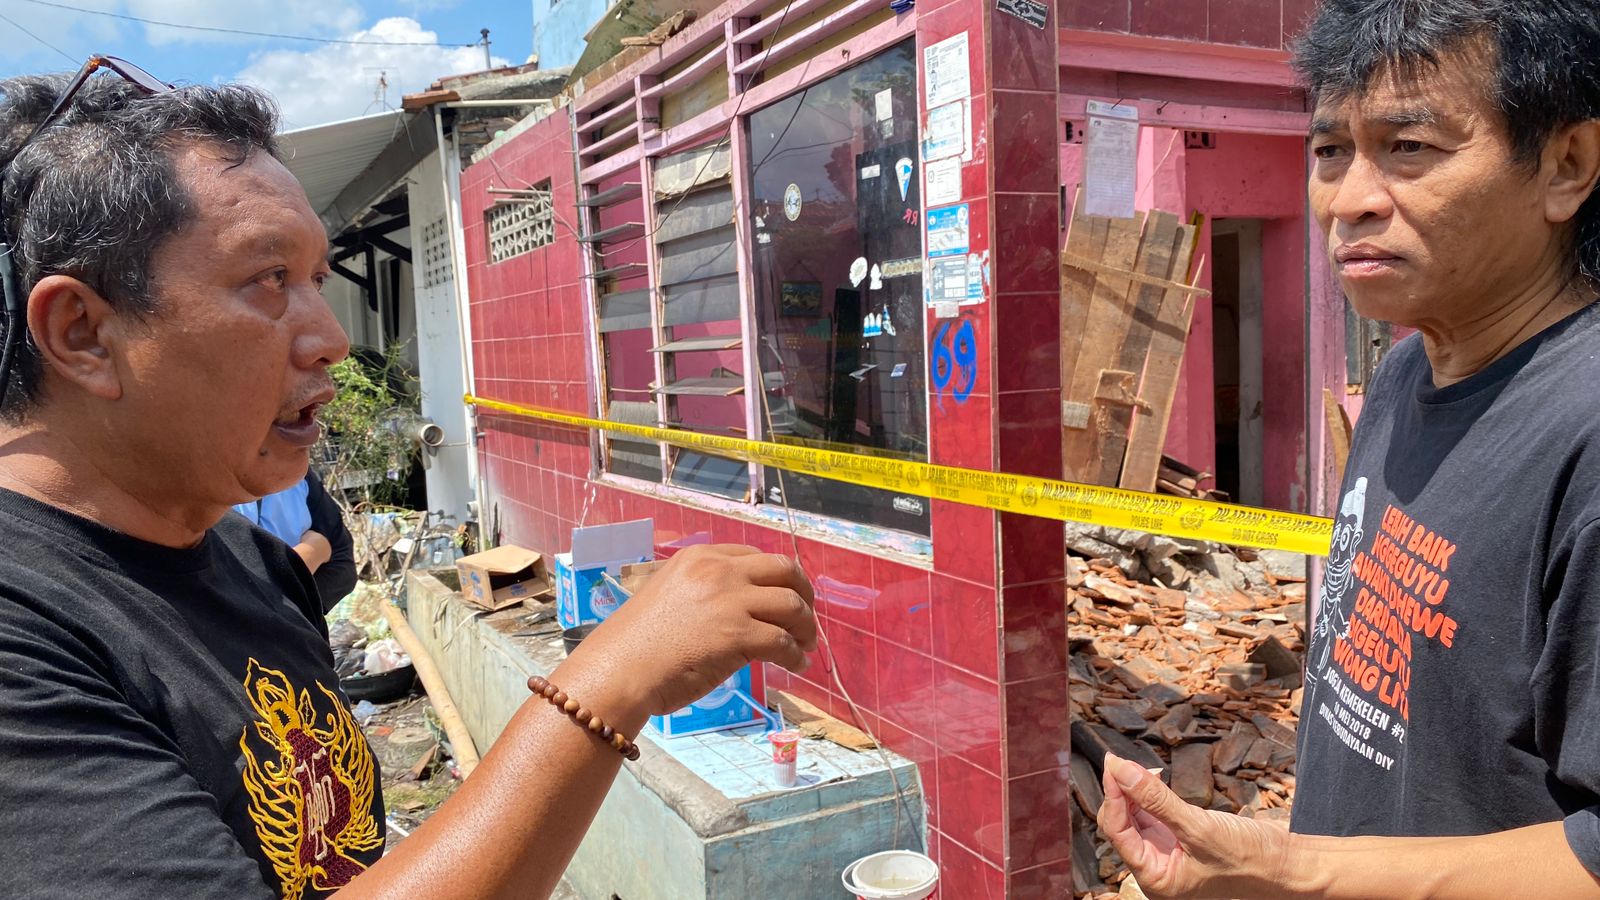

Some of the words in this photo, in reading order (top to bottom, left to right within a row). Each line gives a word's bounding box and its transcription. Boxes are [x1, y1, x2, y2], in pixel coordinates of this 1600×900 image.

[931, 319, 977, 408] 69
[1370, 530, 1450, 606] NGGEGUYU
[1381, 503, 1415, 546] LEBIH
[1406, 524, 1457, 572] BAIK
[1388, 581, 1458, 649] DHEWE
[1333, 635, 1380, 693] WONG
[1332, 717, 1375, 760] KEBUDAYAAN
[1374, 751, 1395, 771] DIY
[1338, 706, 1352, 726] MEI
[1348, 717, 1372, 740] 2018
[1339, 683, 1391, 731] KEMEKELEN
[1390, 722, 1405, 744] #2
